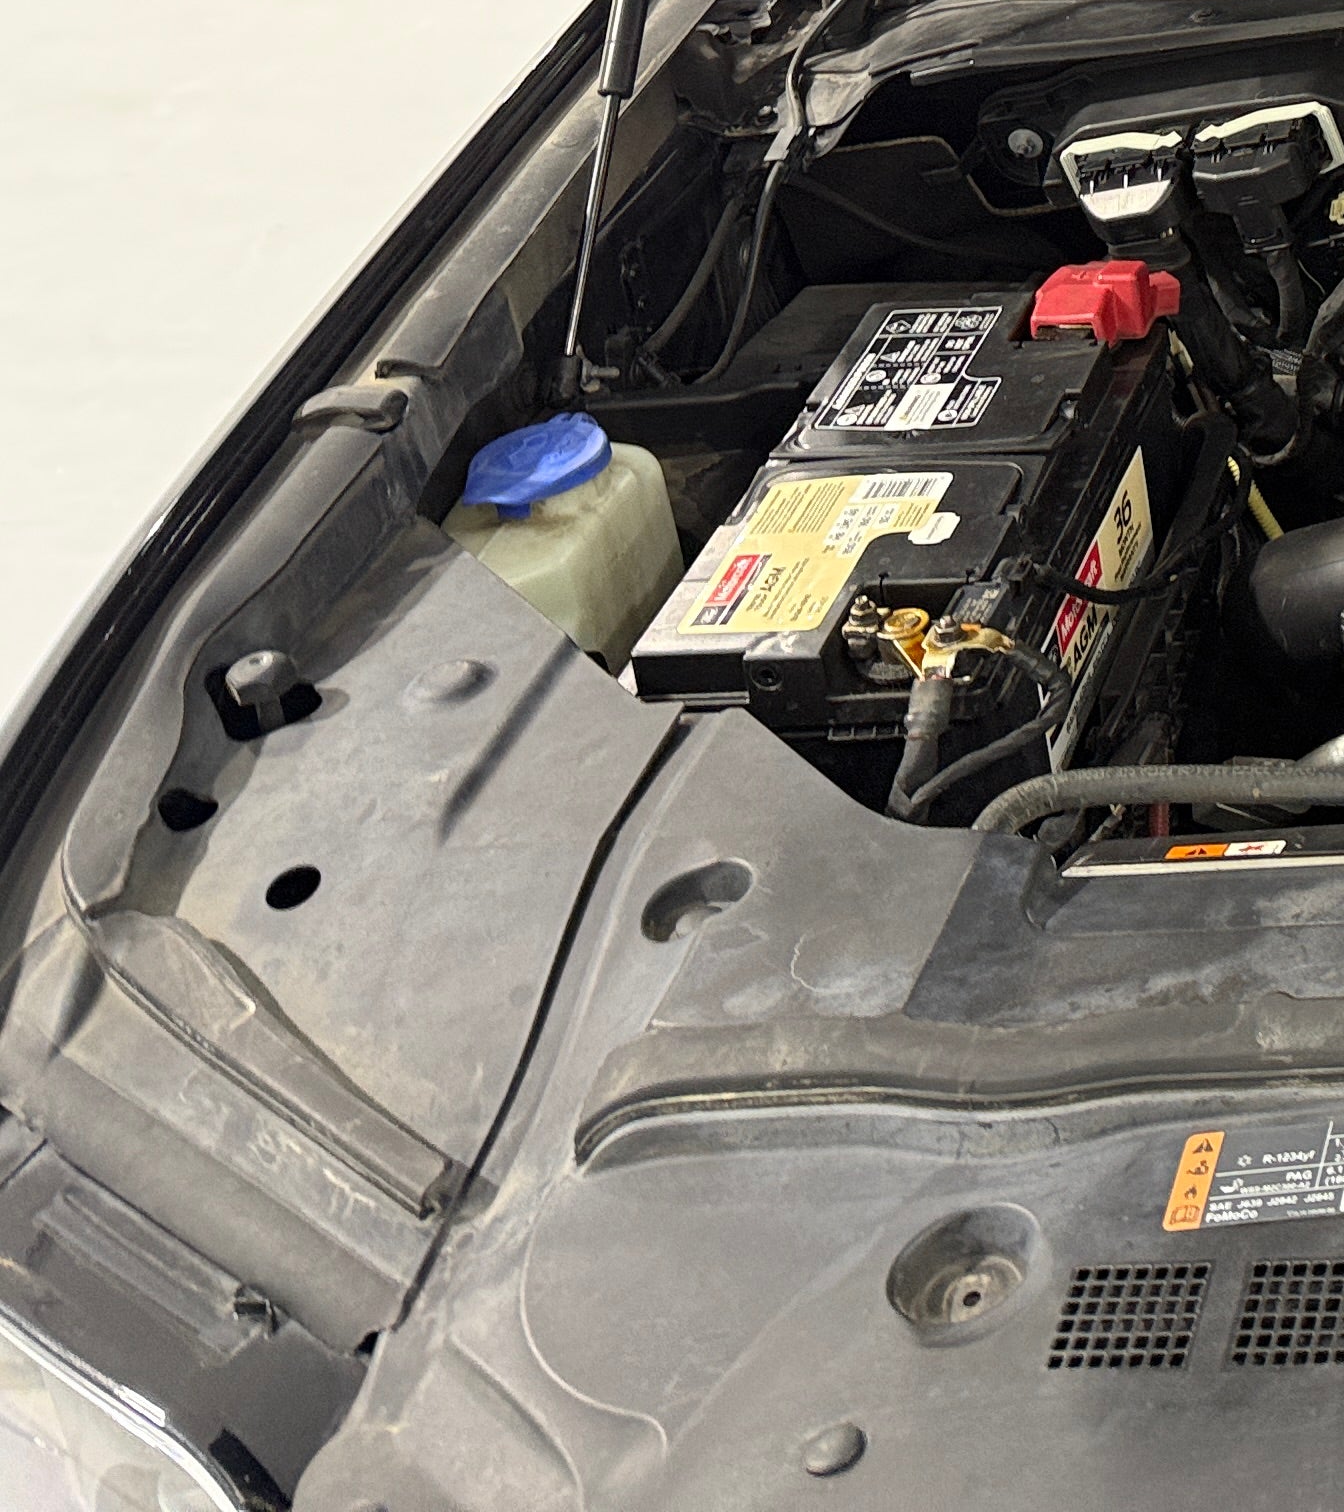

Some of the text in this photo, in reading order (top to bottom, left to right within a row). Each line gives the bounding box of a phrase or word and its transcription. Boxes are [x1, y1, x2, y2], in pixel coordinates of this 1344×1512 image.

[1113, 489, 1132, 545] 36
[1073, 602, 1098, 672] AGM
[1262, 1150, 1316, 1164] R-1234yf
[1285, 1169, 1313, 1181] PAG
[1205, 1208, 1259, 1224] FoMoCo
